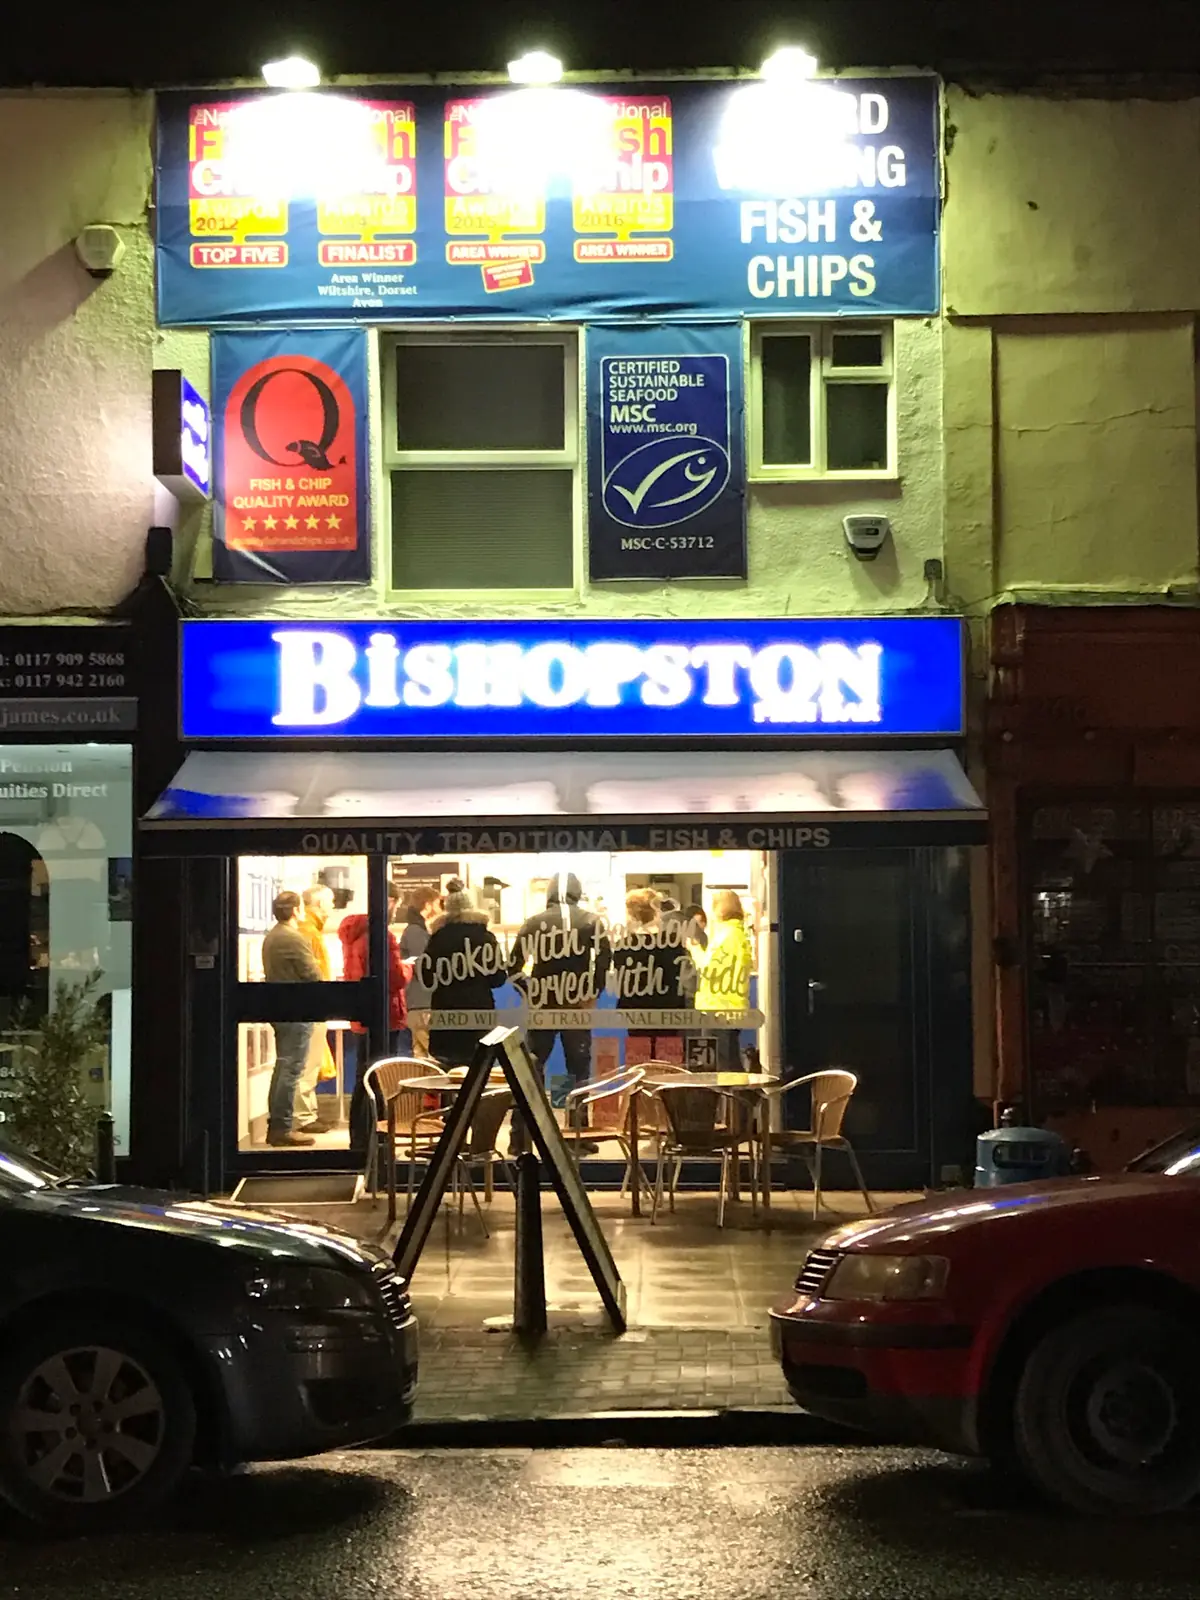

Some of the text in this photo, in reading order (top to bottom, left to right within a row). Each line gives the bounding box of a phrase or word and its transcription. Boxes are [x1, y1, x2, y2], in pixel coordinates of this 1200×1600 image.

[195, 217, 239, 231] 2012
[580, 213, 625, 227] 2016
[740, 199, 883, 243] FISH &
[198, 246, 281, 264] TOP FIVE
[327, 245, 407, 261] FINALIST
[452, 245, 484, 259] AREA
[579, 243, 668, 257] AREA WINNER
[330, 271, 405, 284] Area Winner
[747, 254, 877, 298] CHIPS
[317, 284, 418, 296] Wiltshire, Dorset
[352, 297, 384, 308] Avon
[608, 360, 680, 374] CERTIFIED
[608, 374, 705, 388] SUSTAINABLE
[608, 388, 678, 402] SEAFOOD
[240, 368, 340, 470] Q
[610, 403, 657, 422] MSC
[609, 422, 698, 435] www.msc.org
[250, 477, 333, 491] FISH & CHIP
[233, 494, 350, 509] QUALITY AWARD
[621, 536, 715, 550] MSC-C-53712
[15, 653, 52, 667] 0117
[55, 653, 84, 667] 909
[88, 652, 125, 667] 5868
[15, 673, 52, 688] 0117
[55, 673, 84, 688] 942
[88, 673, 125, 688] 2160
[52, 782, 108, 798] Direct
[302, 827, 831, 853] QUALITY TRADITIONAL FISH & CHIPS
[416, 931, 517, 992] Cooked
[521, 921, 586, 965] with
[508, 954, 748, 1009] Served with Pride
[661, 1011, 694, 1026] FISH
